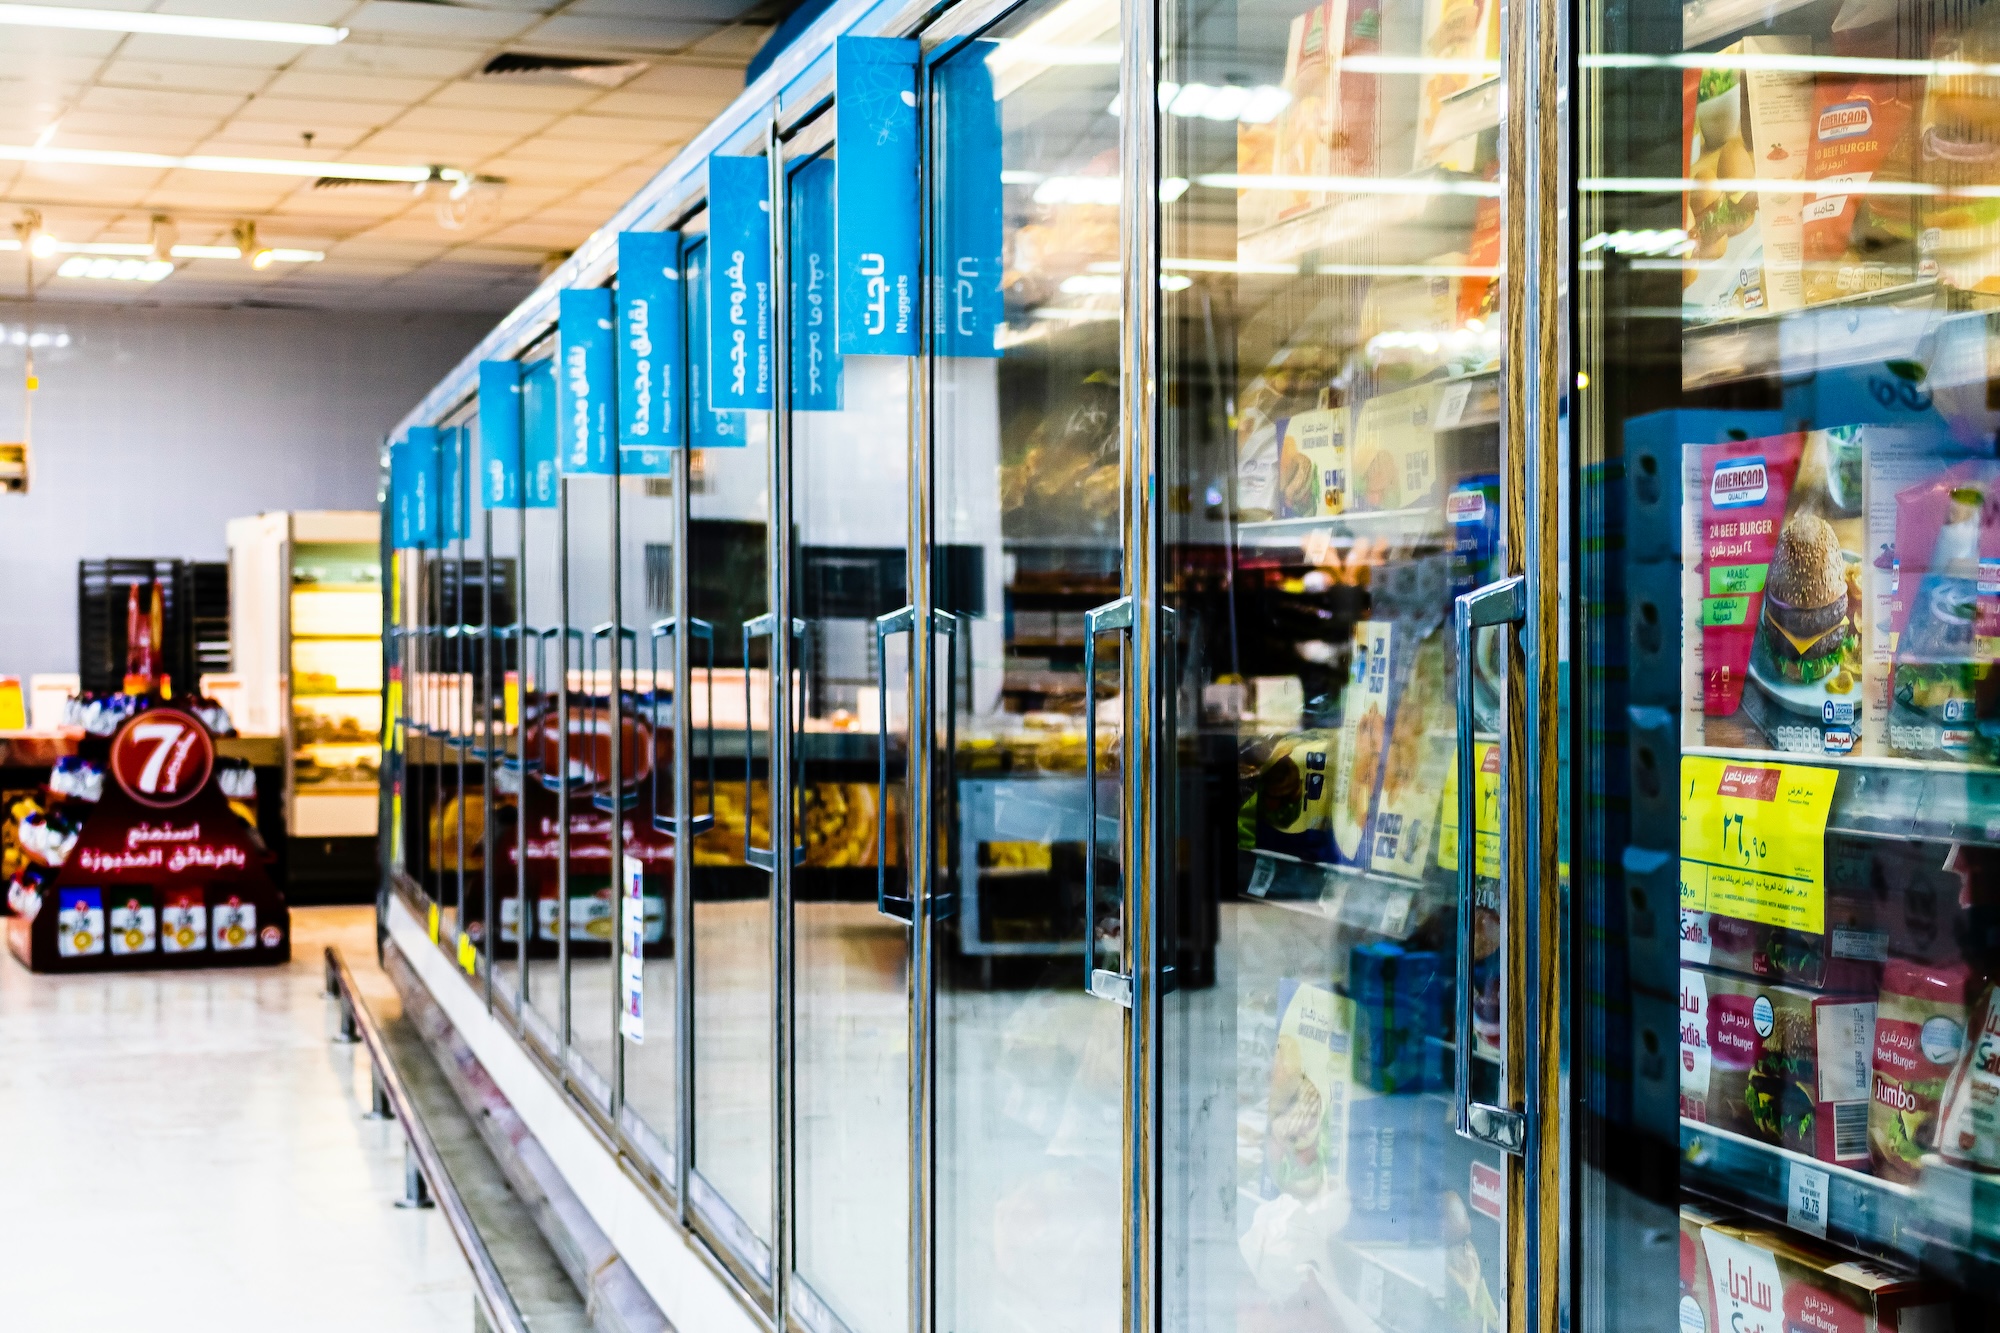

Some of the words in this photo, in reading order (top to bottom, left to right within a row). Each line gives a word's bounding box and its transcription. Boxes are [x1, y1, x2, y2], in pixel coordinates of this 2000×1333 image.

[1820, 109, 1868, 128] AMERICANA
[1823, 144, 1839, 159] BEEF
[1840, 140, 1878, 154] BURGER
[723, 250, 747, 326] مفروم
[860, 253, 892, 336] ناجت
[755, 281, 768, 340] minced
[895, 274, 911, 335] Nuggets
[729, 328, 748, 397] مجمد
[755, 344, 769, 394] frozen
[1714, 468, 1765, 491] AMERICANA
[1727, 491, 1749, 501] QUALITY
[1709, 525, 1719, 539] 24
[1720, 523, 1738, 538] BEEF
[1739, 519, 1773, 536] BURGER
[1727, 544, 1744, 558] برجر
[1726, 567, 1750, 579] ARABIC
[1726, 580, 1748, 593] SPICES
[133, 723, 186, 794] 7
[1736, 1015, 1750, 1029] برجر
[1681, 1022, 1700, 1048] adia
[1717, 1030, 1732, 1043] Beef
[1733, 1034, 1754, 1053] Burger
[1897, 1035, 1916, 1051] برجر
[1877, 1047, 1892, 1061] Beef
[1892, 1051, 1918, 1072] Burger
[1875, 1077, 1917, 1112] Jumbo
[1802, 1196, 1820, 1214] 19.75
[1801, 1309, 1816, 1325] Beef
[1816, 1315, 1839, 1333] Burger
